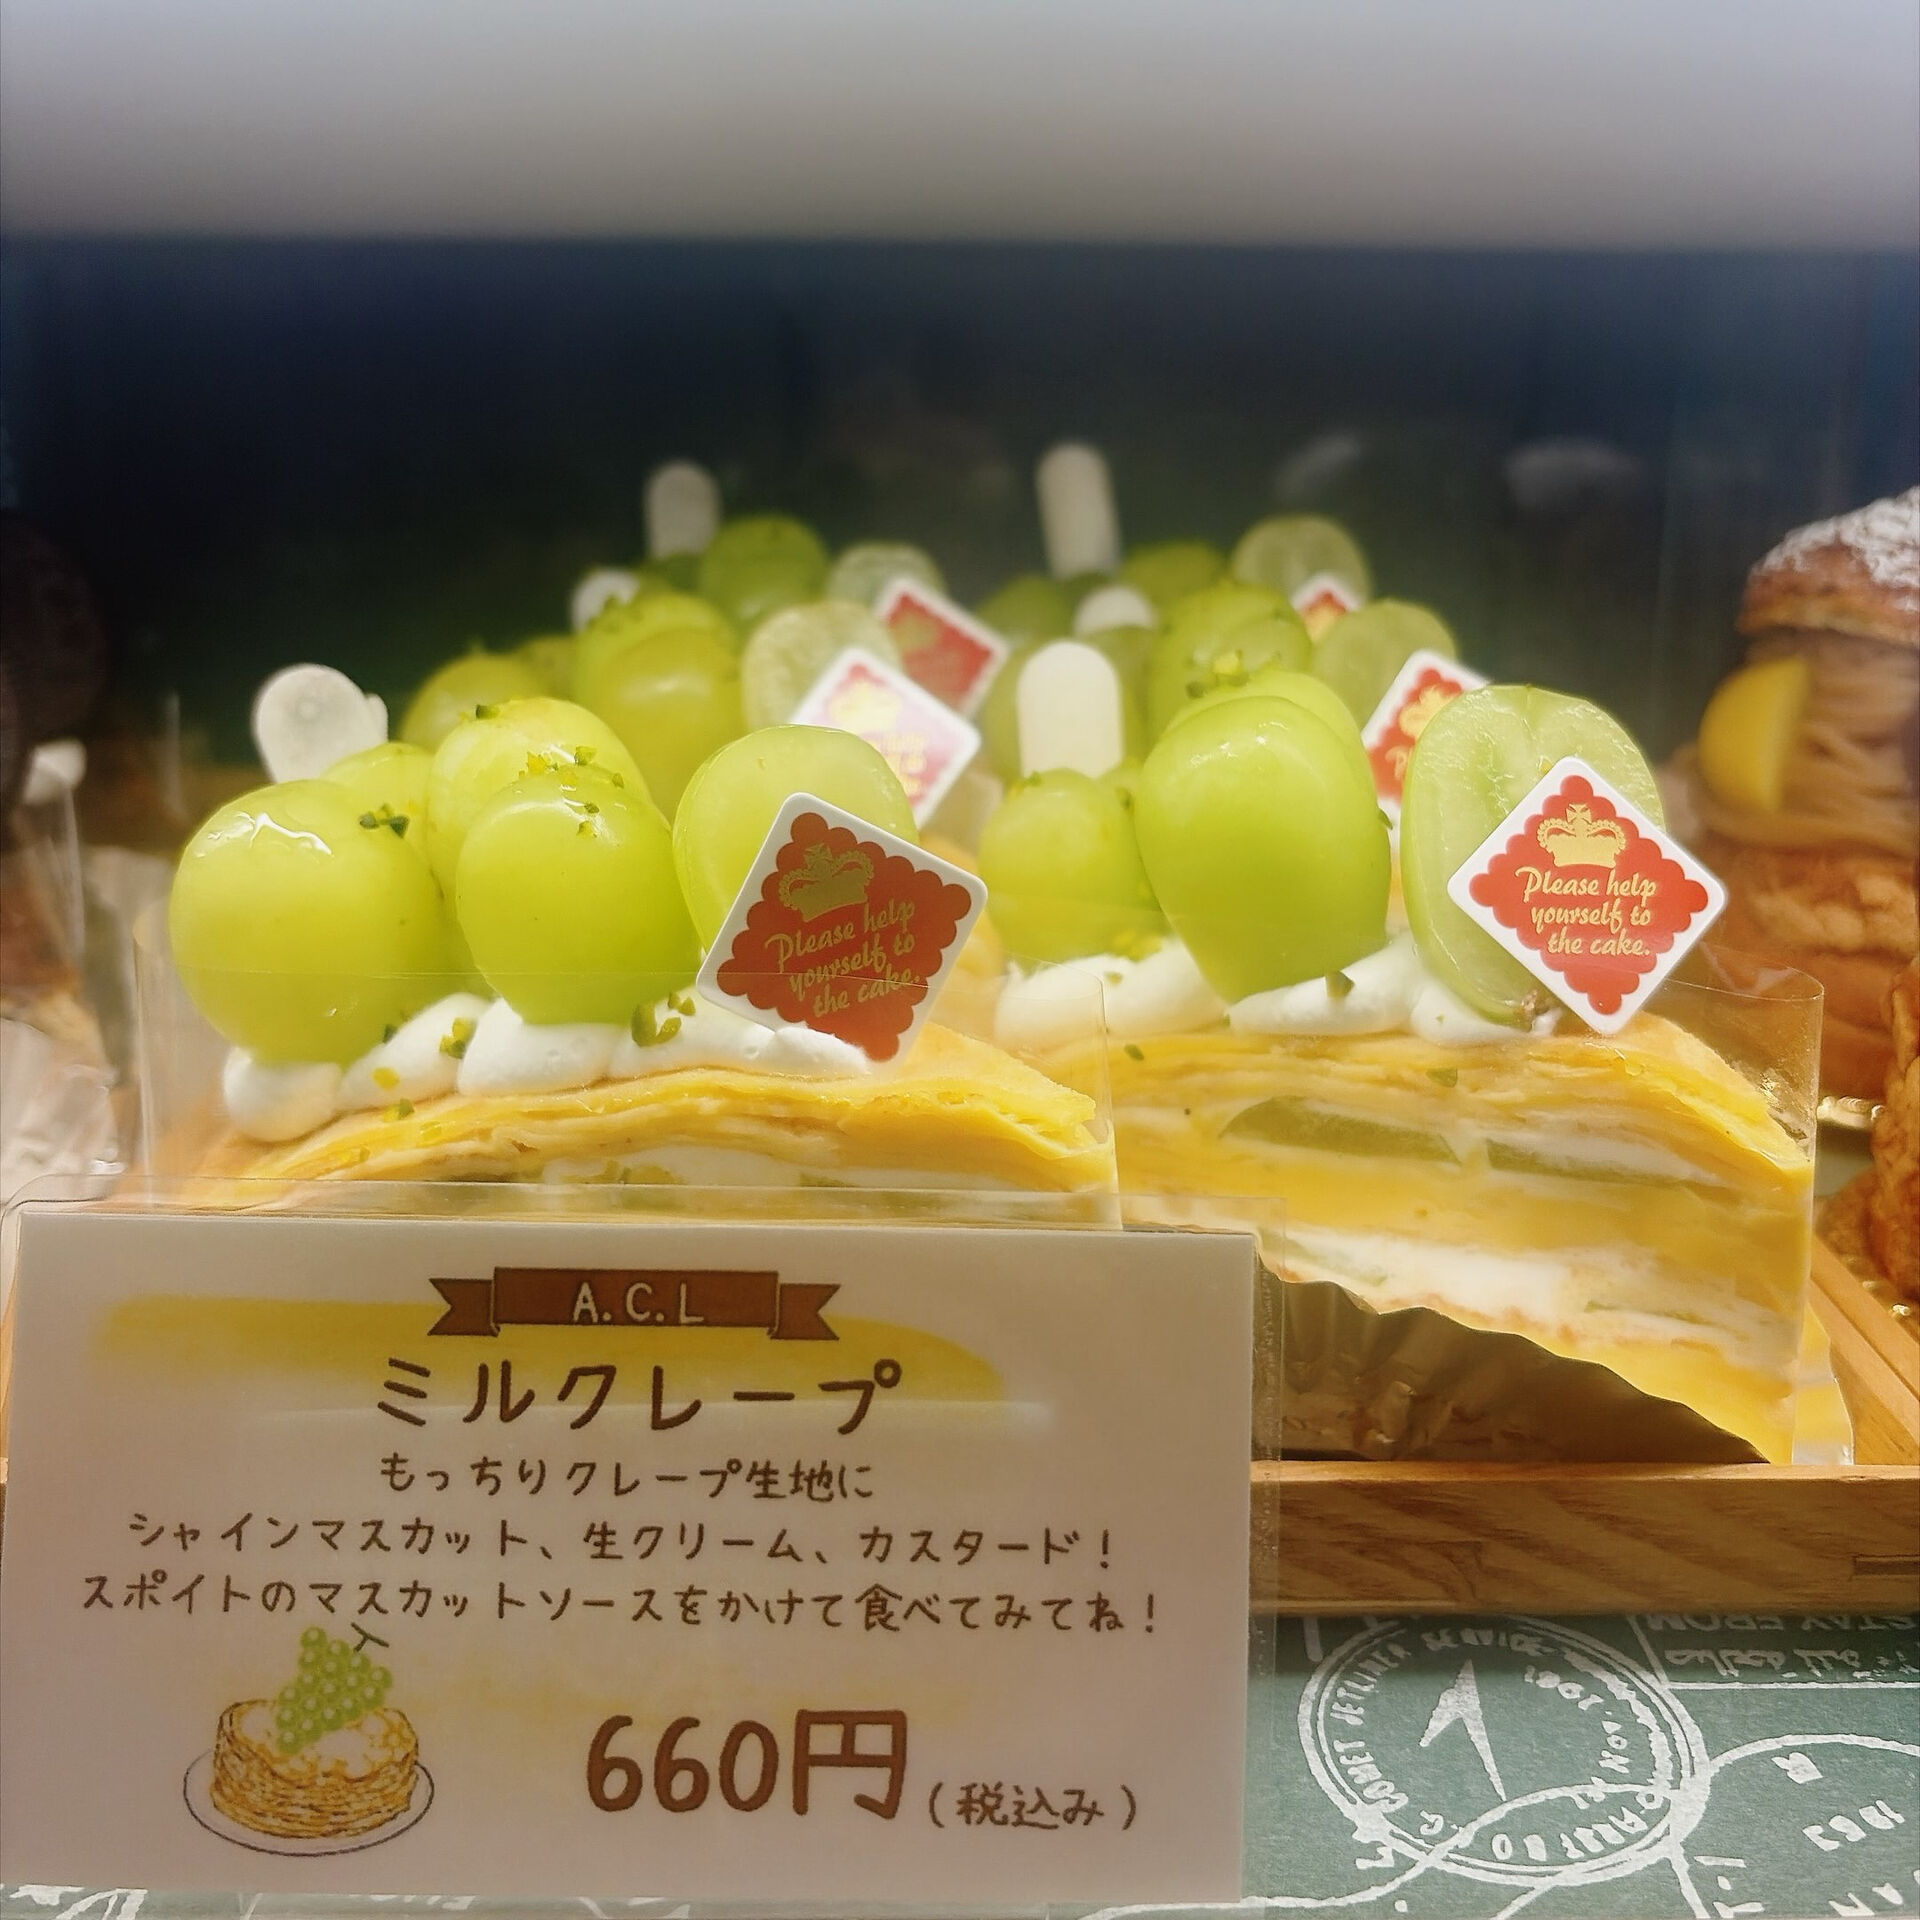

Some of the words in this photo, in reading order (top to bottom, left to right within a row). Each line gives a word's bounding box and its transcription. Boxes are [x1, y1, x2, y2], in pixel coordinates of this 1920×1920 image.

[1515, 866, 1599, 903] Please
[1606, 869, 1657, 907] help
[765, 920, 857, 974] Please
[863, 899, 916, 932] help
[1531, 898, 1623, 934] yourself
[1630, 907, 1651, 926] to
[1548, 926, 1583, 954] the
[1590, 928, 1650, 956] cake.
[789, 937, 888, 1000] yourself
[894, 935, 916, 956] to
[812, 986, 850, 1018] the
[857, 964, 921, 1002] cake.
[572, 1282, 704, 1323] A.C.L
[377, 1358, 902, 1435] ミルクレープ
[381, 1452, 873, 1504] もっちりクレープ生地に
[586, 1709, 907, 1819] 660円
